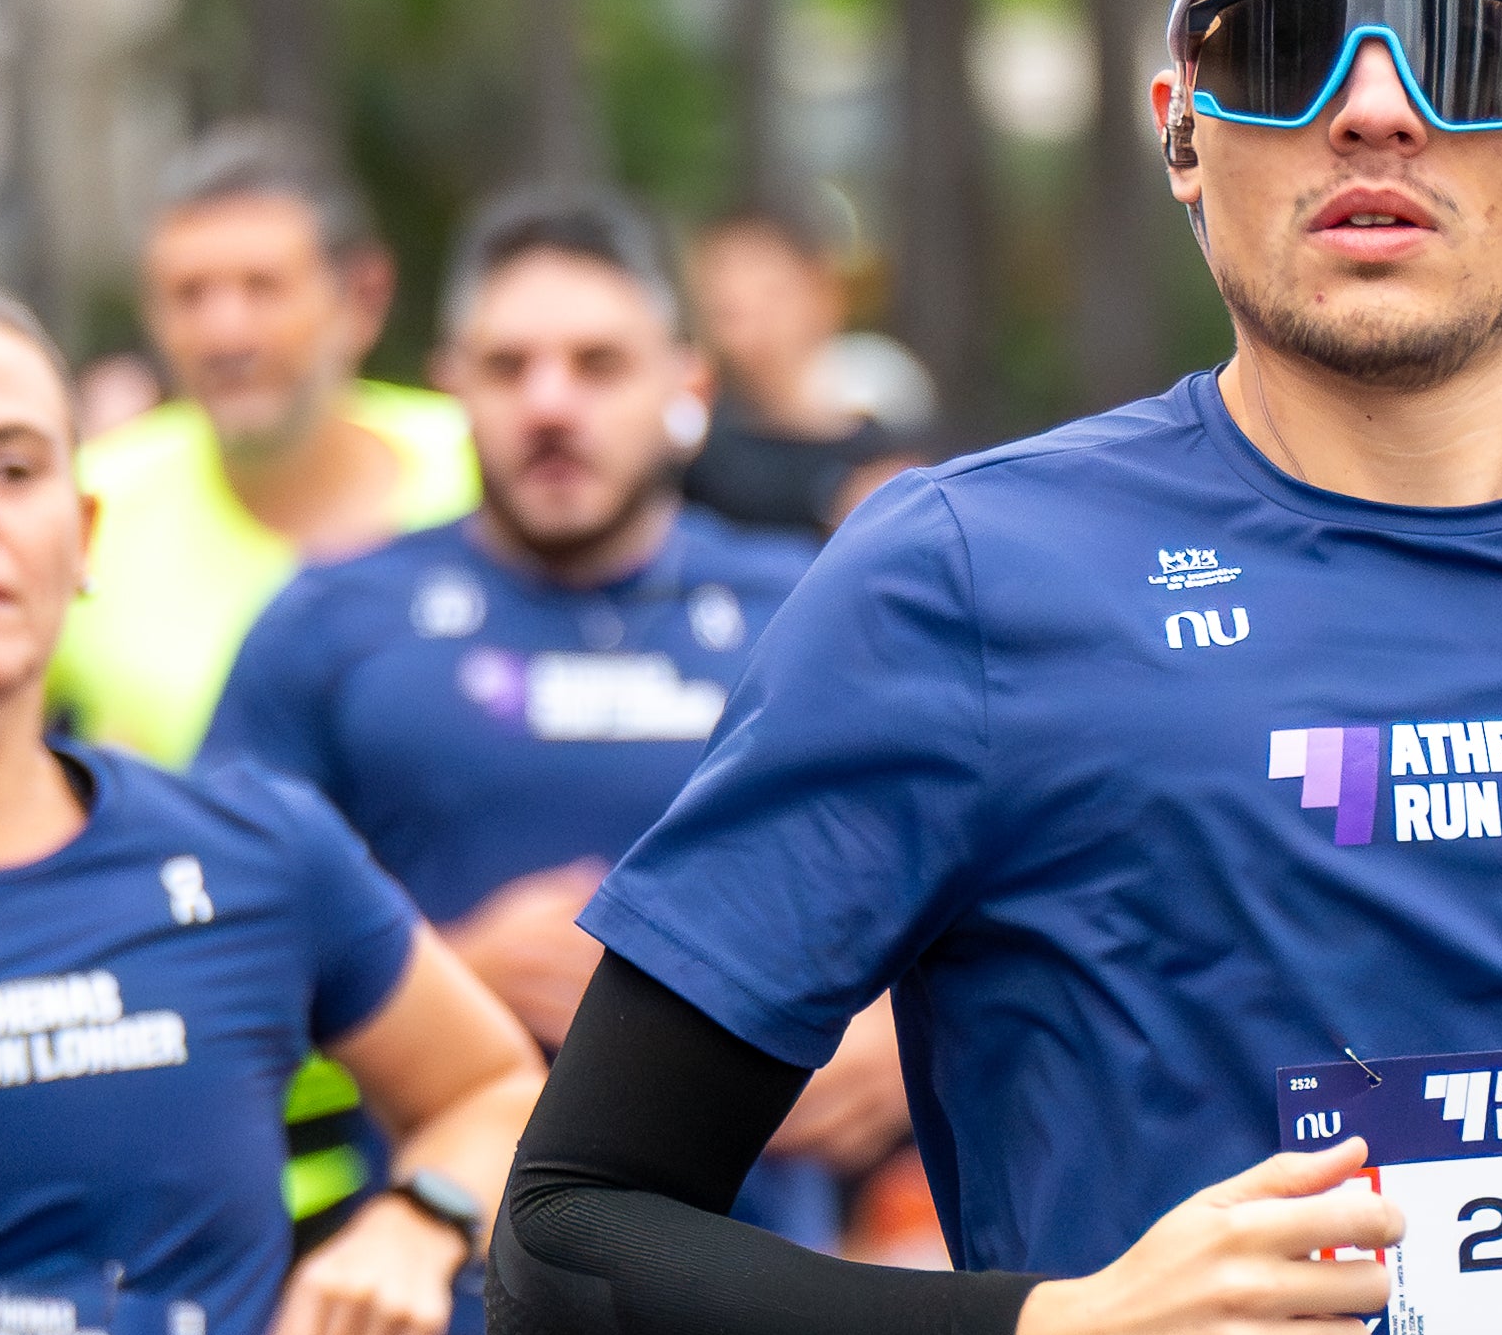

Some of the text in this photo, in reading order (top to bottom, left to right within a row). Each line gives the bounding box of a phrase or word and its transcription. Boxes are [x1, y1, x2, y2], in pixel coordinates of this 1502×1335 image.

[1165, 607, 1250, 649] nu
[1394, 781, 1502, 842] RUN
[1290, 1076, 1318, 1091] 2526
[1296, 1110, 1341, 1140] nu
